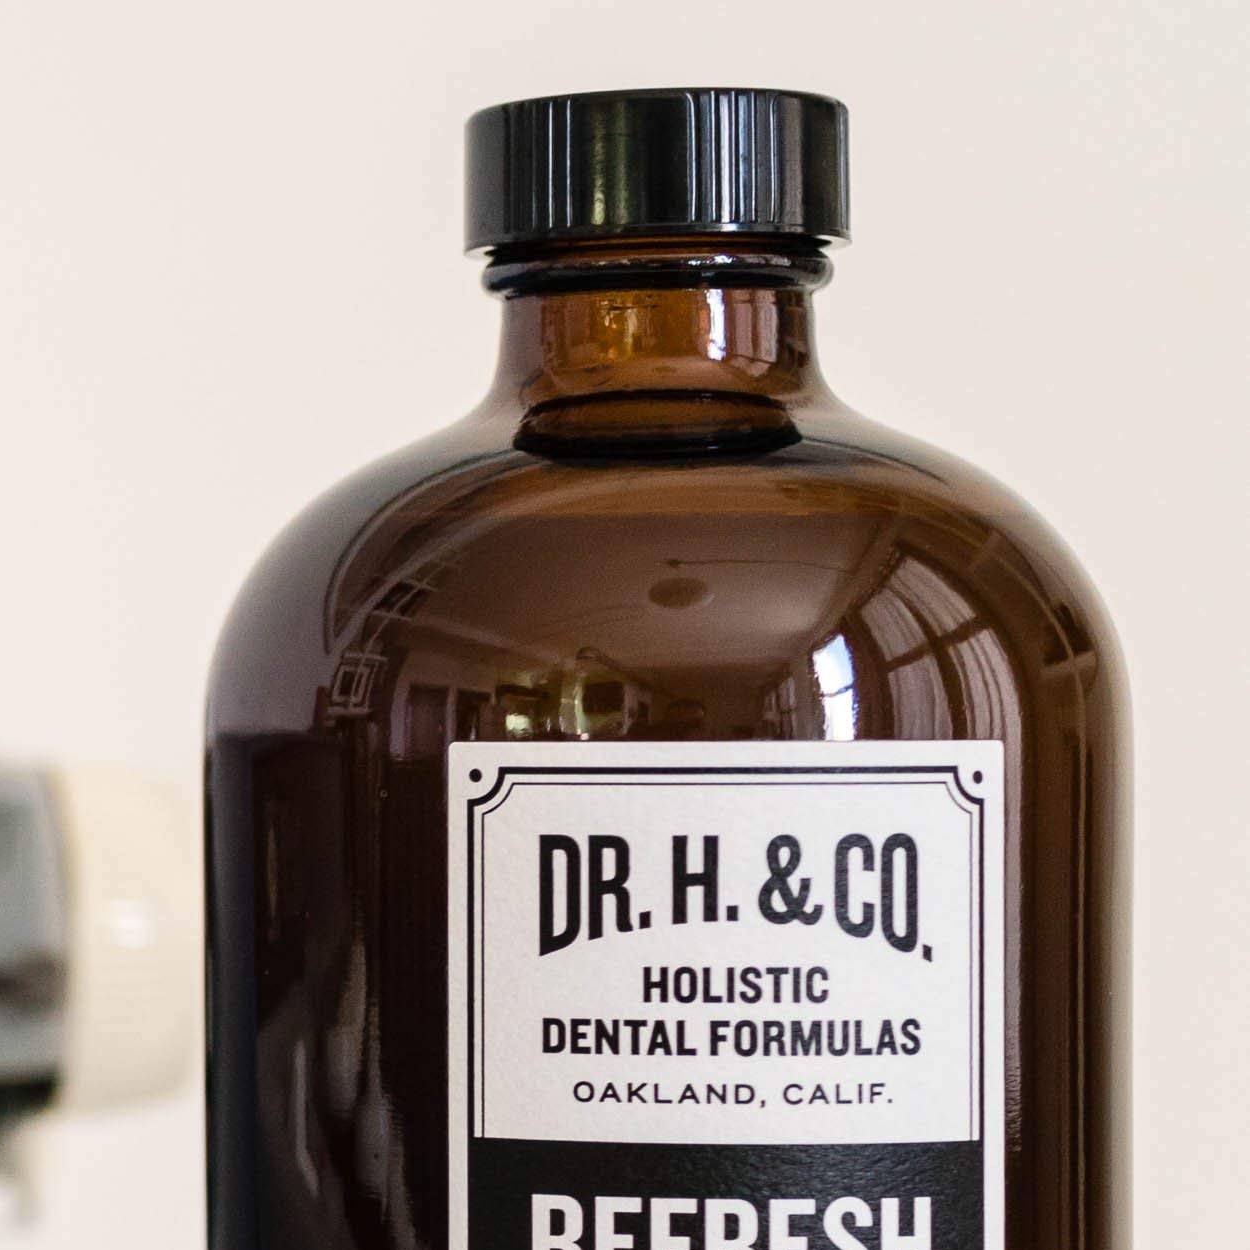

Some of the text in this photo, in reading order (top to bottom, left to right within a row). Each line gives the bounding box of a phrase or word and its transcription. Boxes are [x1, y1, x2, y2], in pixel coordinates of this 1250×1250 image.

[538, 832, 933, 963] DR. H. & CO.
[642, 966, 829, 1004] HOLISTIC
[542, 1017, 921, 1058] DENTAL FORMULAS
[572, 1080, 893, 1108] OAKLAND, CALIF.
